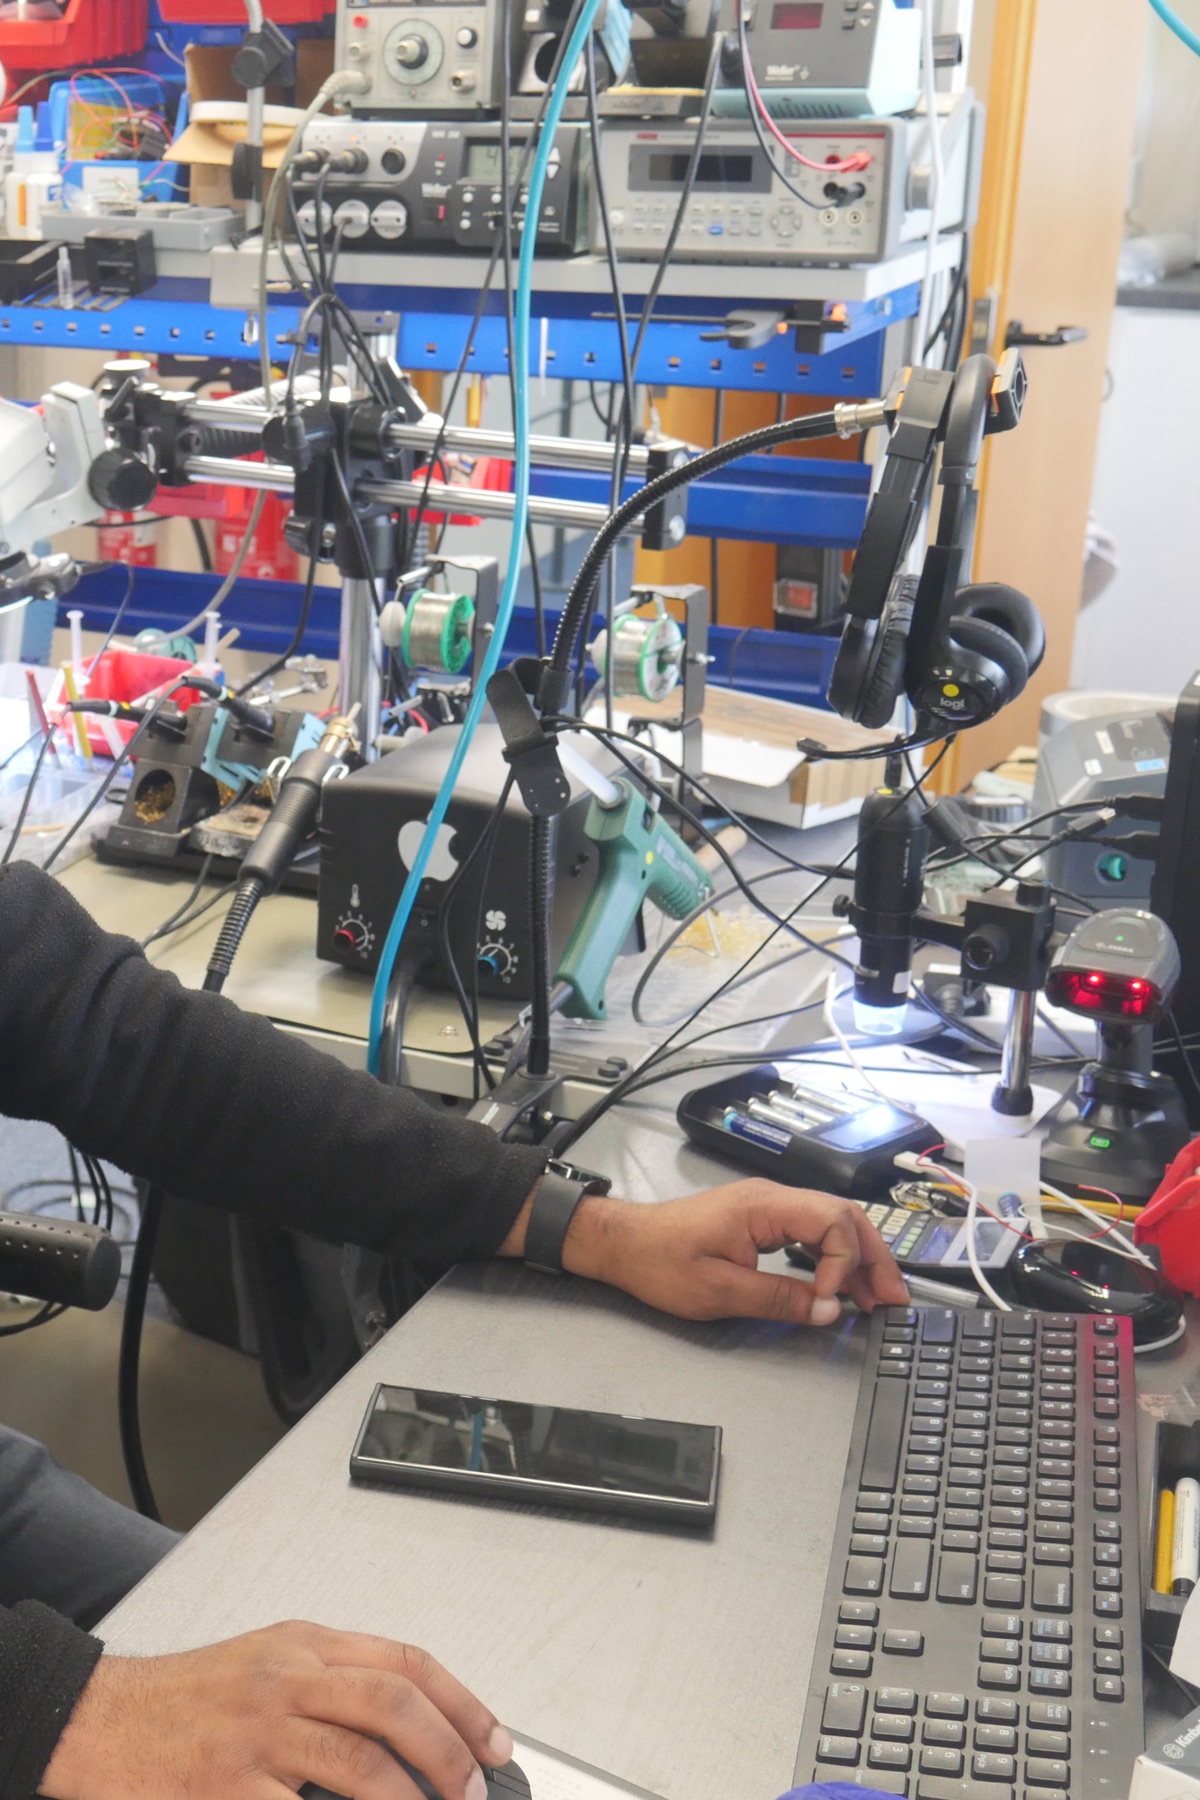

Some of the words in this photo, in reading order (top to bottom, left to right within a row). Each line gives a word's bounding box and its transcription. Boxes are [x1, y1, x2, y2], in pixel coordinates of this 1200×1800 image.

[940, 697, 965, 711] logi
[1019, 1356, 1029, 1364] W
[925, 1456, 936, 1464] M
[1108, 1544, 1116, 1553] F10
[1109, 1568, 1117, 1577] F11
[913, 1581, 922, 1592] Shift
[961, 1584, 970, 1597] Enter
[1057, 1583, 1066, 1605] Backspace
[1109, 1593, 1117, 1602] F12
[1007, 1616, 1016, 1631] Delete
[1057, 1621, 1065, 1635] Insert
[1006, 1641, 1014, 1651] End
[1056, 1645, 1064, 1660] Home
[1054, 1671, 1064, 1684] PgUp
[831, 1683, 840, 1697] Insert
[881, 1687, 890, 1698] End
[982, 1697, 991, 1712] Home
[1047, 1705, 1055, 1717] Lock
[1055, 1705, 1063, 1718] Num
[822, 1736, 832, 1752] Delete
[873, 1742, 883, 1756] PgDn
[977, 1753, 987, 1768] PgUp
